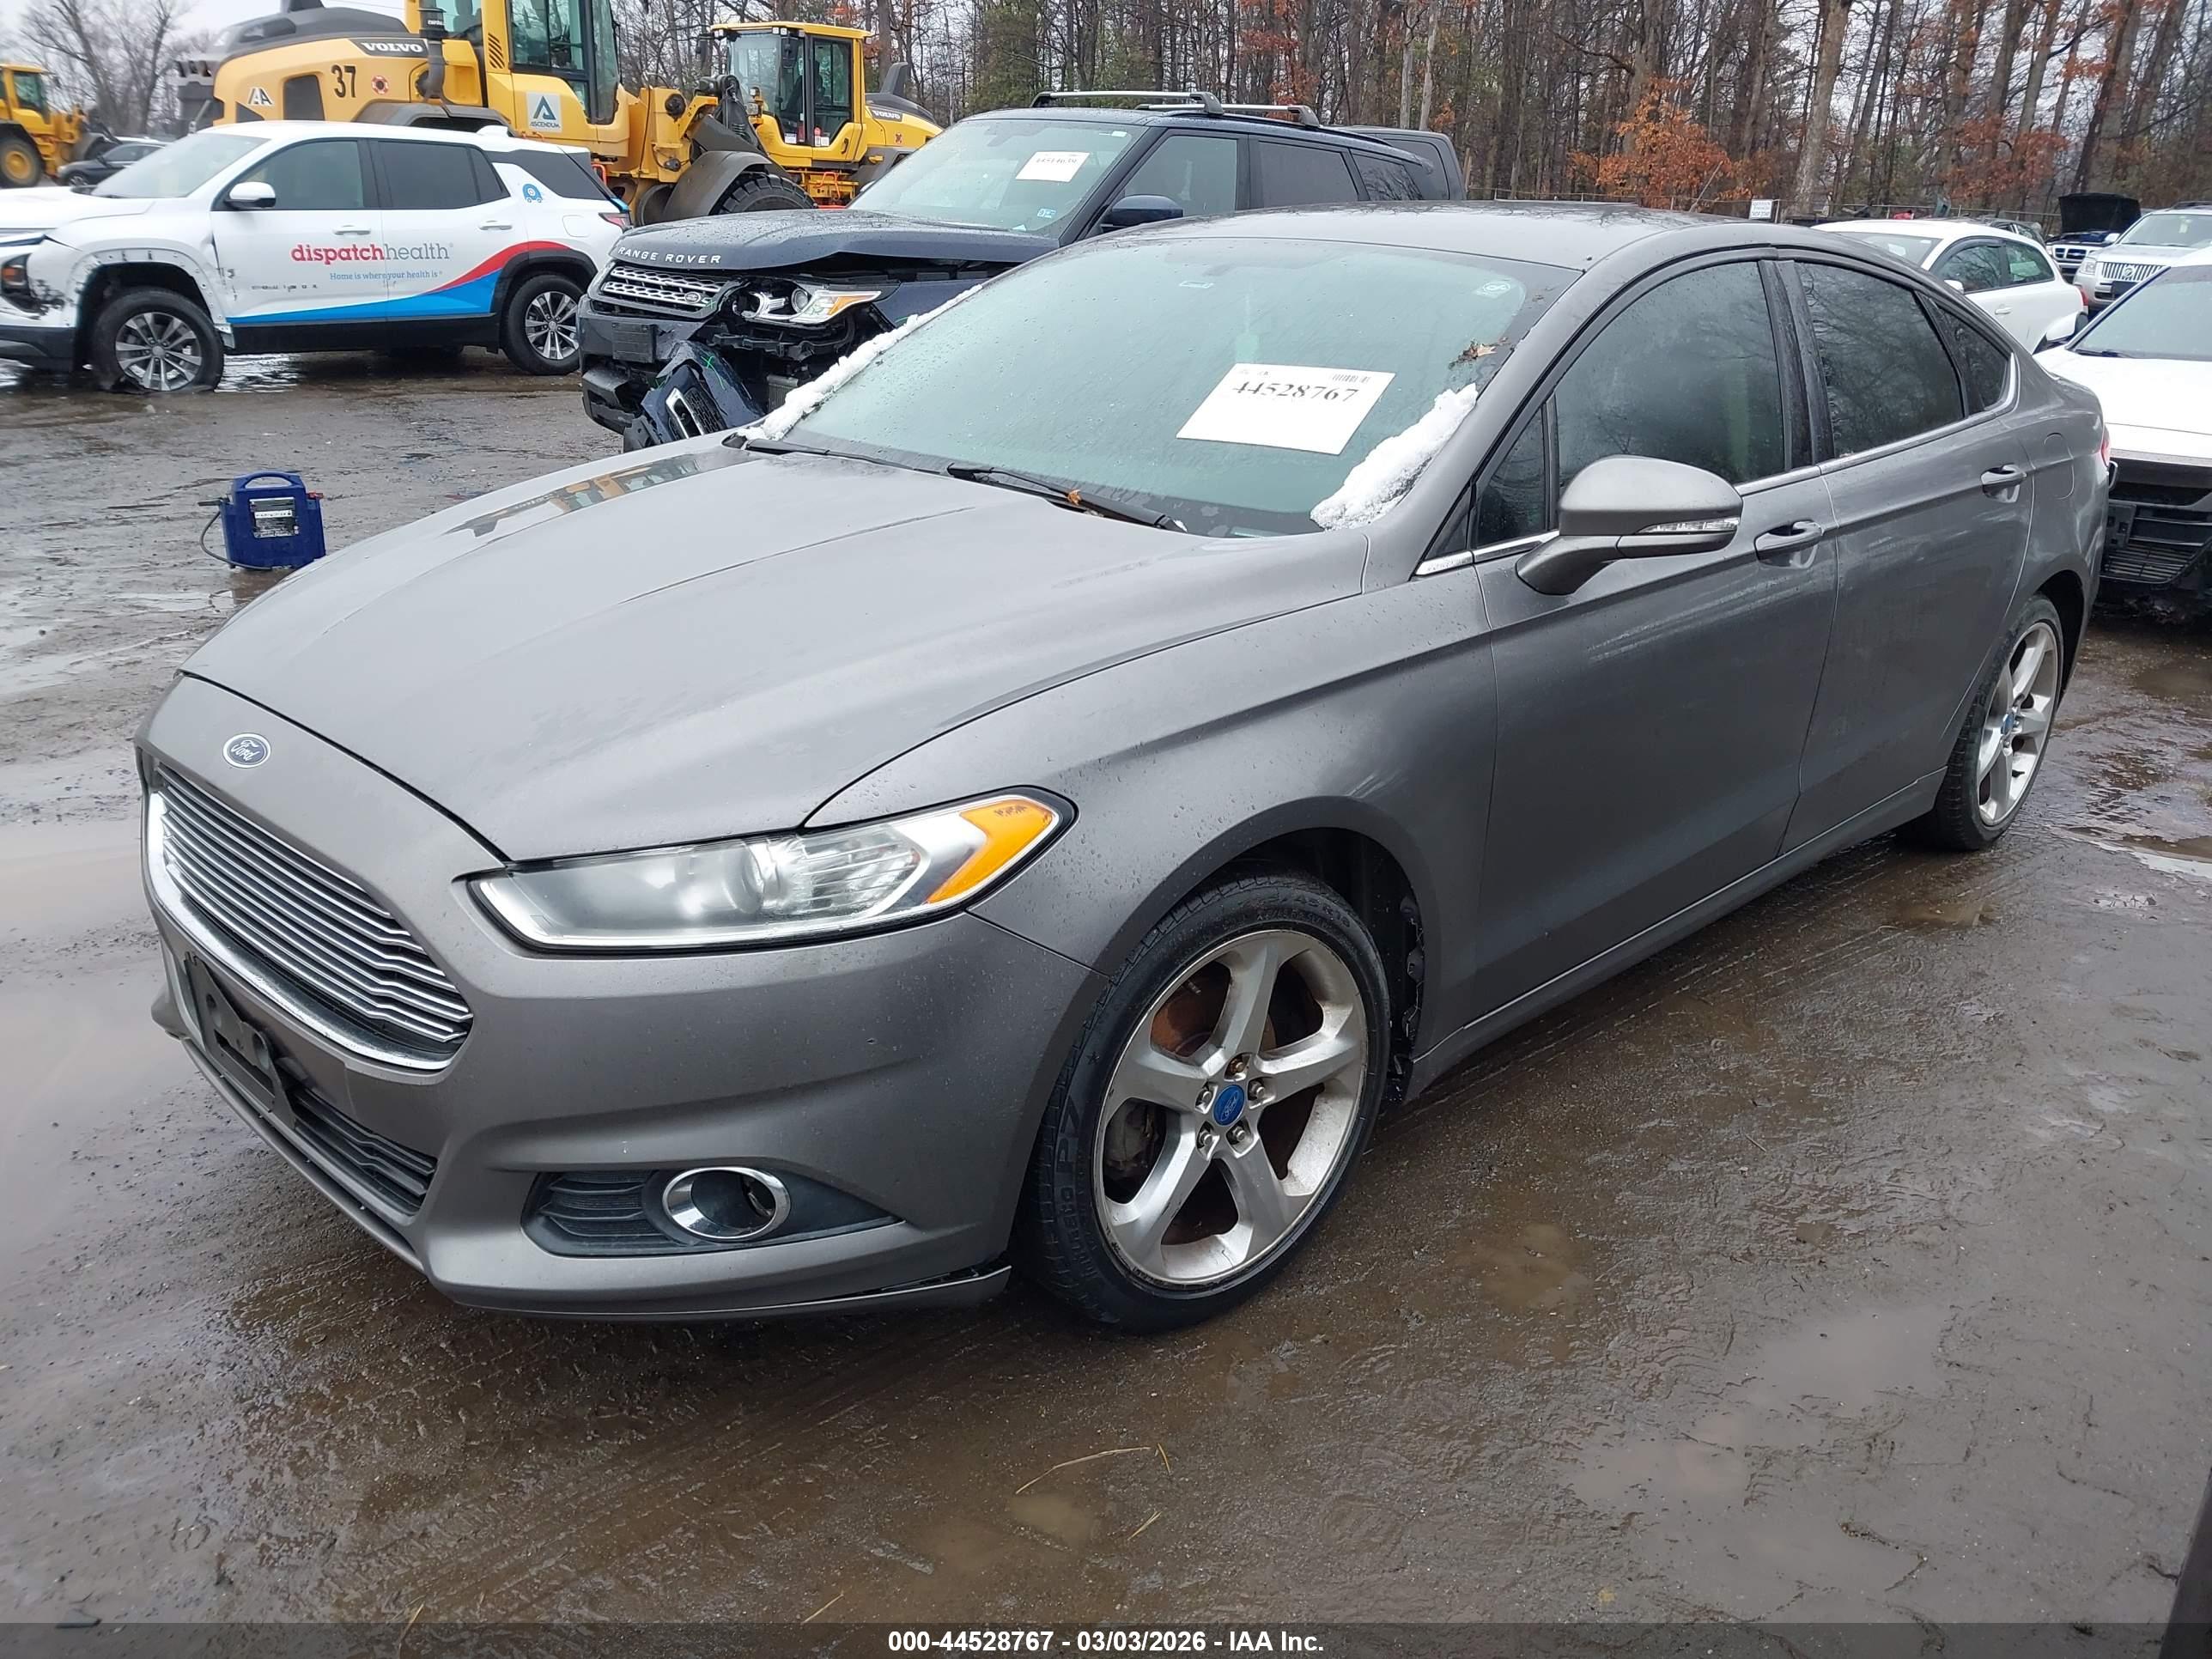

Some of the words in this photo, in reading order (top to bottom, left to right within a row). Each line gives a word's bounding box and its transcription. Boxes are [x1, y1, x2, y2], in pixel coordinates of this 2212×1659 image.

[362, 41, 423, 53] VOLVO
[331, 64, 357, 99] 37
[872, 109, 901, 119] VOLVO
[617, 246, 659, 261] RANGE
[665, 253, 721, 264] ROVER
[362, 271, 386, 280] where
[386, 272, 405, 281] your
[407, 270, 430, 278] health
[1232, 381, 1359, 402] 44528767
[230, 739, 261, 762] Ford
